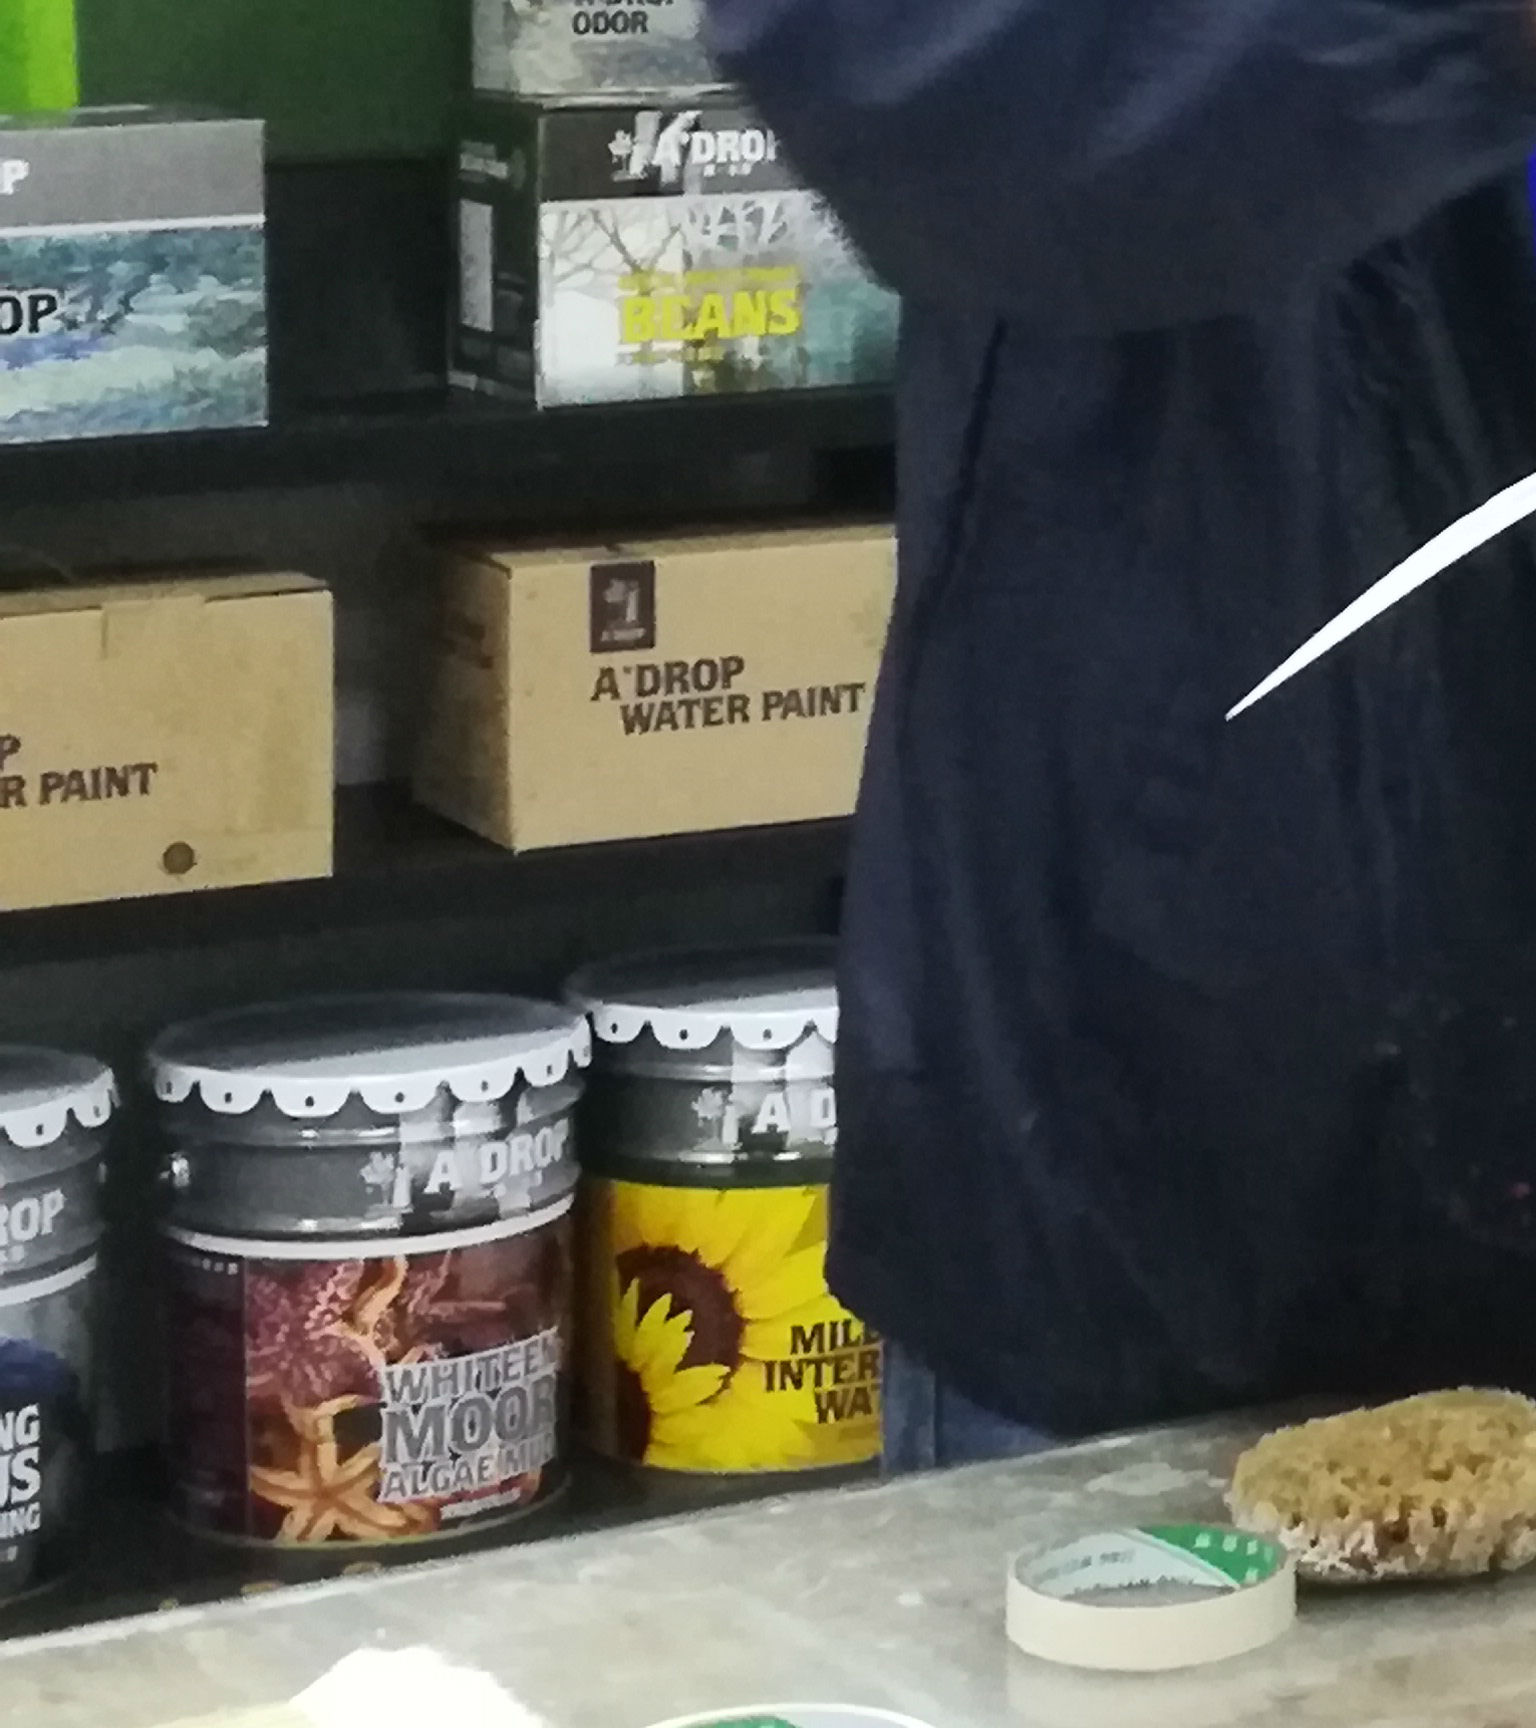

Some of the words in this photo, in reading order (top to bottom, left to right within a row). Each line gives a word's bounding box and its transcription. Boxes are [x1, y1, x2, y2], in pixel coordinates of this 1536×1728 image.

[572, 10, 649, 35] ODOR
[619, 693, 751, 736] WATER
[761, 682, 867, 722] PAINT
[39, 761, 159, 806] PAINT
[383, 1454, 493, 1498] ALGAE
